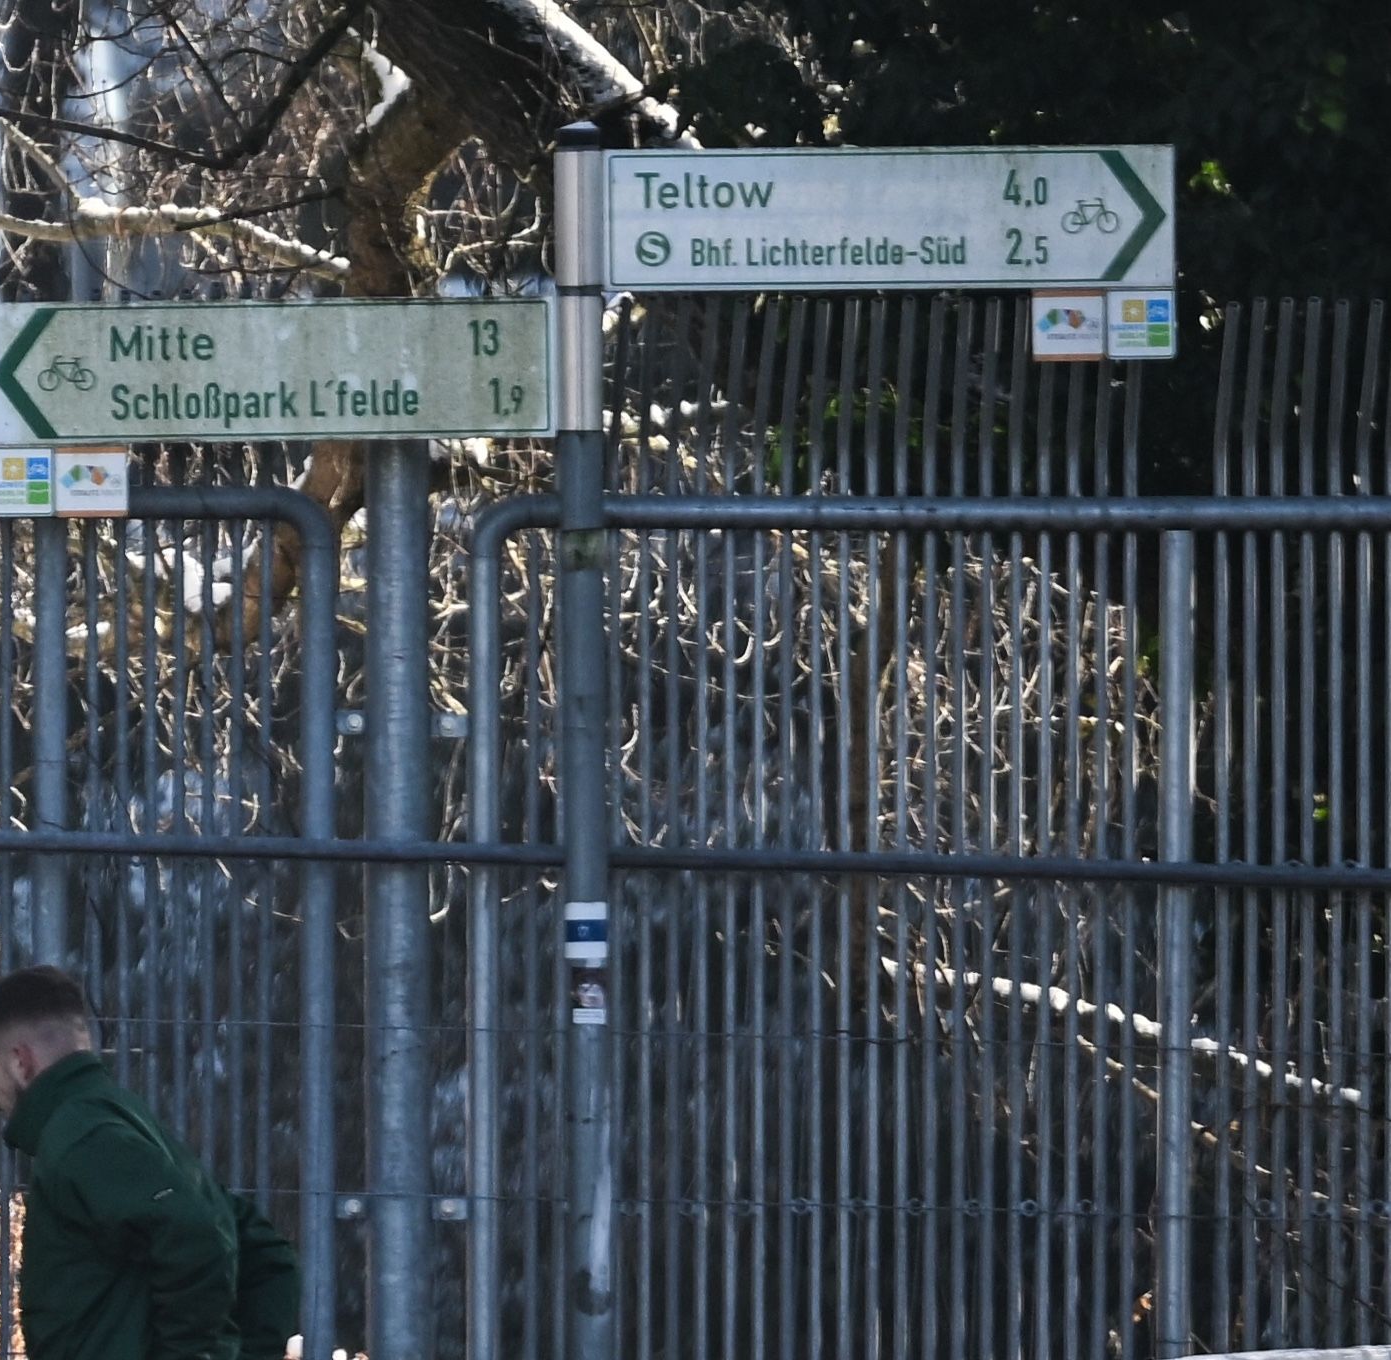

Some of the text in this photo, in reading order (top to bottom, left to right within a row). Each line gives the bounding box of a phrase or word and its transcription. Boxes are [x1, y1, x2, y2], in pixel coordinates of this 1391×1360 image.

[633, 168, 1048, 209] Teltow 4,0
[691, 238, 738, 267] Bhf.
[746, 235, 967, 267] Lichterfelde-Süd
[1004, 227, 1048, 268] 2,5
[110, 318, 500, 362] Mitte 13
[111, 381, 297, 429] Schloßpark
[488, 377, 525, 416] 1,9
